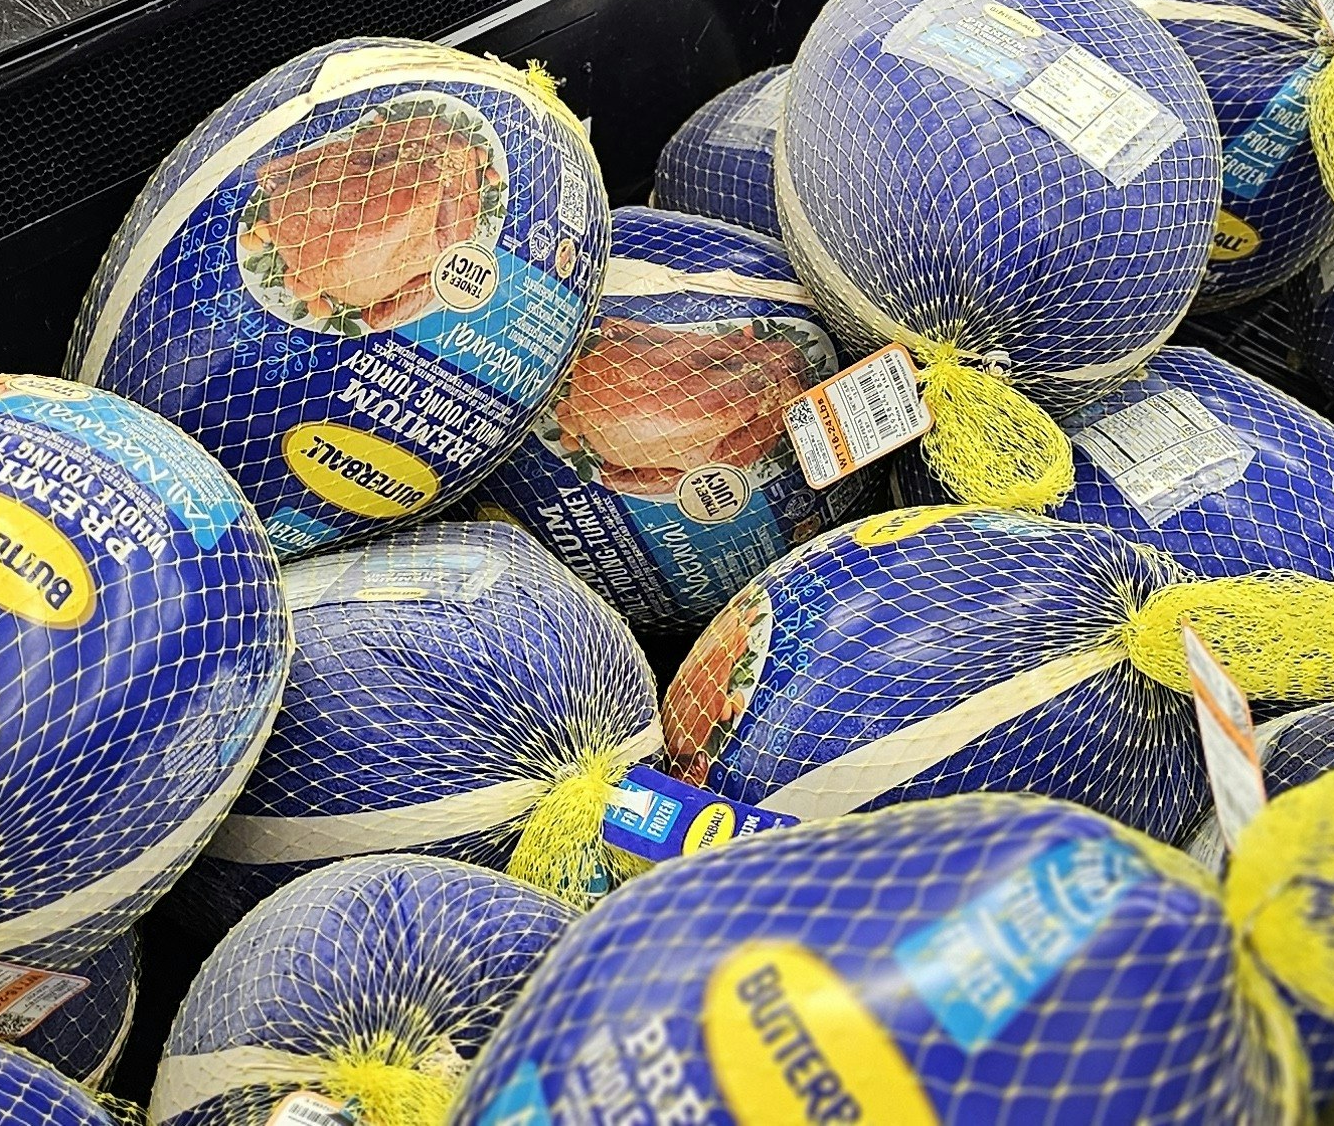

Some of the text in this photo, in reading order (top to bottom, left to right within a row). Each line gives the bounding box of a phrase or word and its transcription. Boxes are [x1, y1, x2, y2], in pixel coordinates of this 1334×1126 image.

[1267, 103, 1310, 132] FROZEN
[1243, 130, 1290, 160] FROZEN
[1221, 154, 1268, 187] FROZEN
[441, 270, 483, 299] TENDER &
[445, 253, 492, 286] JUICY
[341, 349, 506, 449] WHOLE YOUNG TURKEY
[817, 397, 829, 421] Lbs
[337, 377, 483, 468] PREMIUM
[1181, 423, 1199, 437] 160
[15, 443, 91, 495] YOUNG
[299, 434, 426, 509] BUTTERBALL
[836, 451, 848, 470] WT
[168, 485, 211, 522] All
[693, 486, 720, 518] TENDER
[702, 471, 739, 510] JUICY
[96, 482, 168, 560] WHOLE
[266, 519, 321, 552] FROZEN
[559, 486, 639, 595] YOUNG TURKEY
[647, 799, 678, 838] FROZEN
